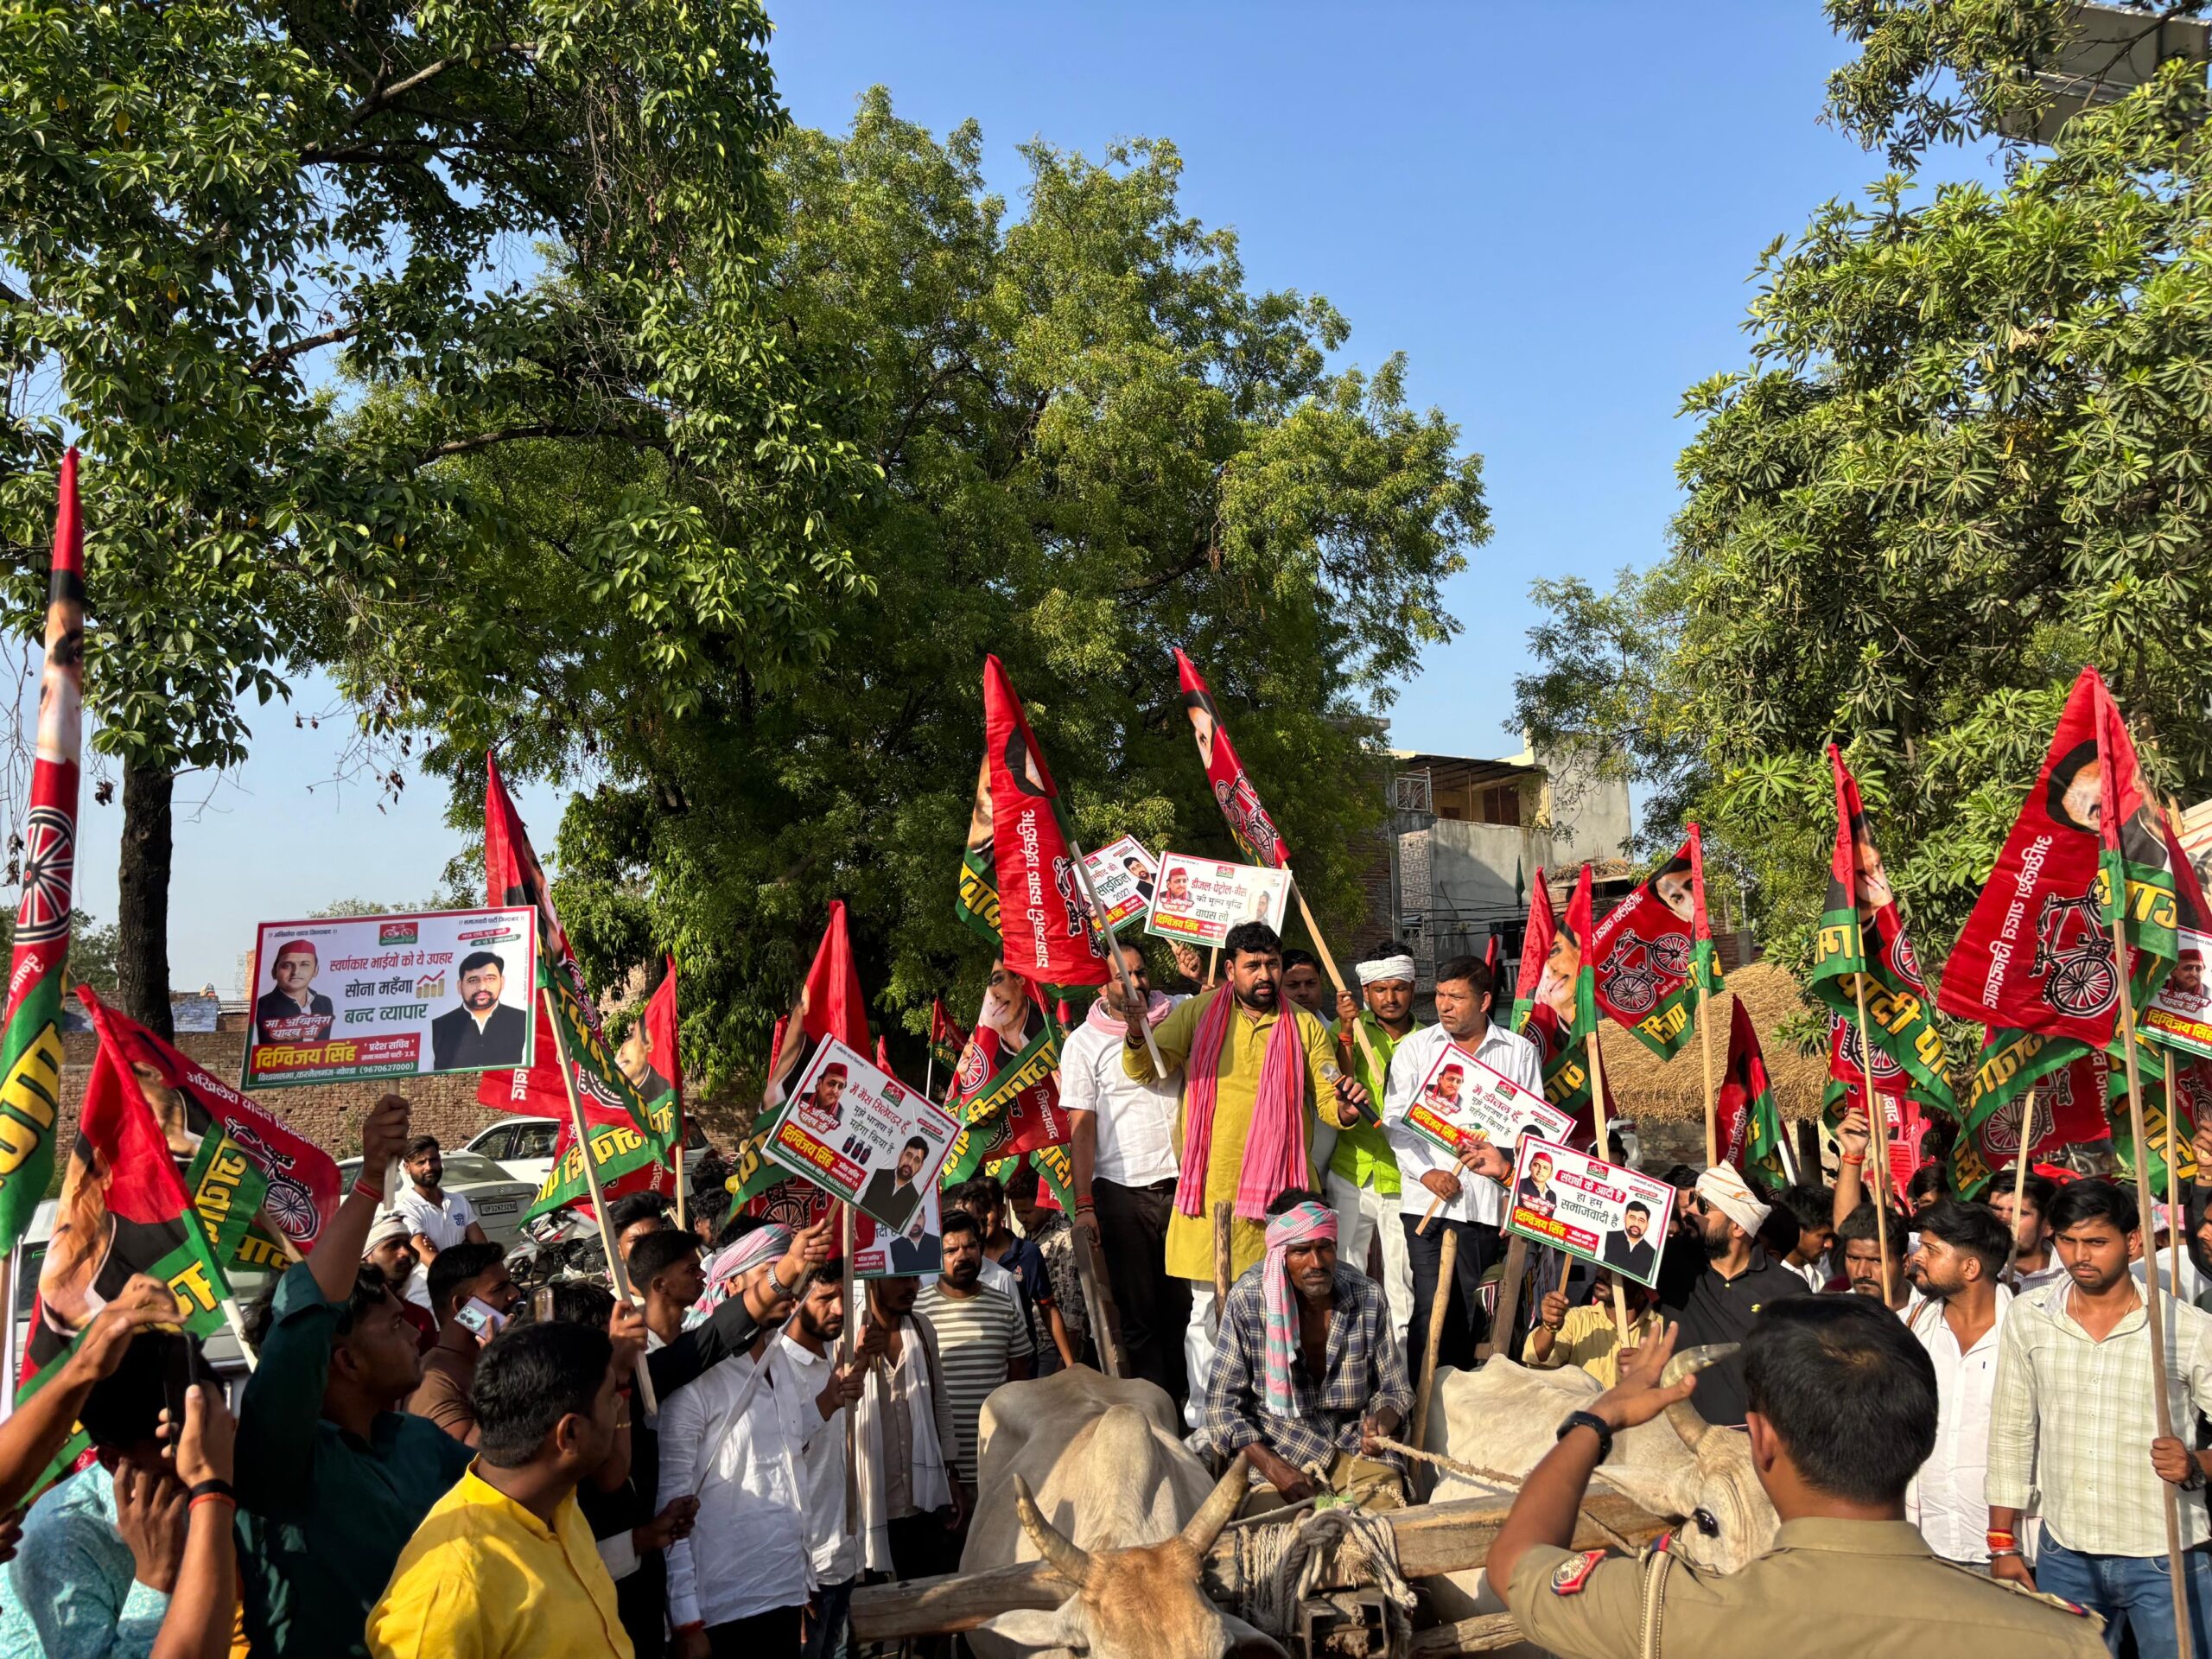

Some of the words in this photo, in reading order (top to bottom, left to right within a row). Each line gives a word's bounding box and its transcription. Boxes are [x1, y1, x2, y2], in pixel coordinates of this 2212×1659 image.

[1113, 887, 1130, 901] 2027
[1196, 908, 1217, 920] वापस
[1218, 911, 1229, 922] लो
[330, 955, 368, 971] स्वर्णकार
[371, 952, 398, 969] भाईयों
[402, 952, 414, 966] को
[416, 950, 424, 965] ये
[427, 952, 454, 965] उपहार
[345, 979, 375, 998] सोना
[378, 976, 414, 995] महँगा
[345, 1006, 375, 1024] बन्द
[380, 1003, 429, 1020] व्यापार
[2147, 1009, 2193, 1033] दिग्विजय
[256, 1046, 322, 1069] दिग्विजय
[325, 1040, 358, 1064] सिंह
[359, 1062, 414, 1074] (9670627000)
[187, 1071, 238, 1104] अखिलेश
[1483, 1092, 1512, 1114] डीजल
[867, 1114, 887, 1132] भाजपा
[781, 1124, 818, 1157] दिग्विजय
[815, 1146, 835, 1168] सिंह
[868, 1129, 887, 1149] किया
[1560, 1198, 1610, 1224] समाजवादी
[1590, 1197, 1603, 1209] हम
